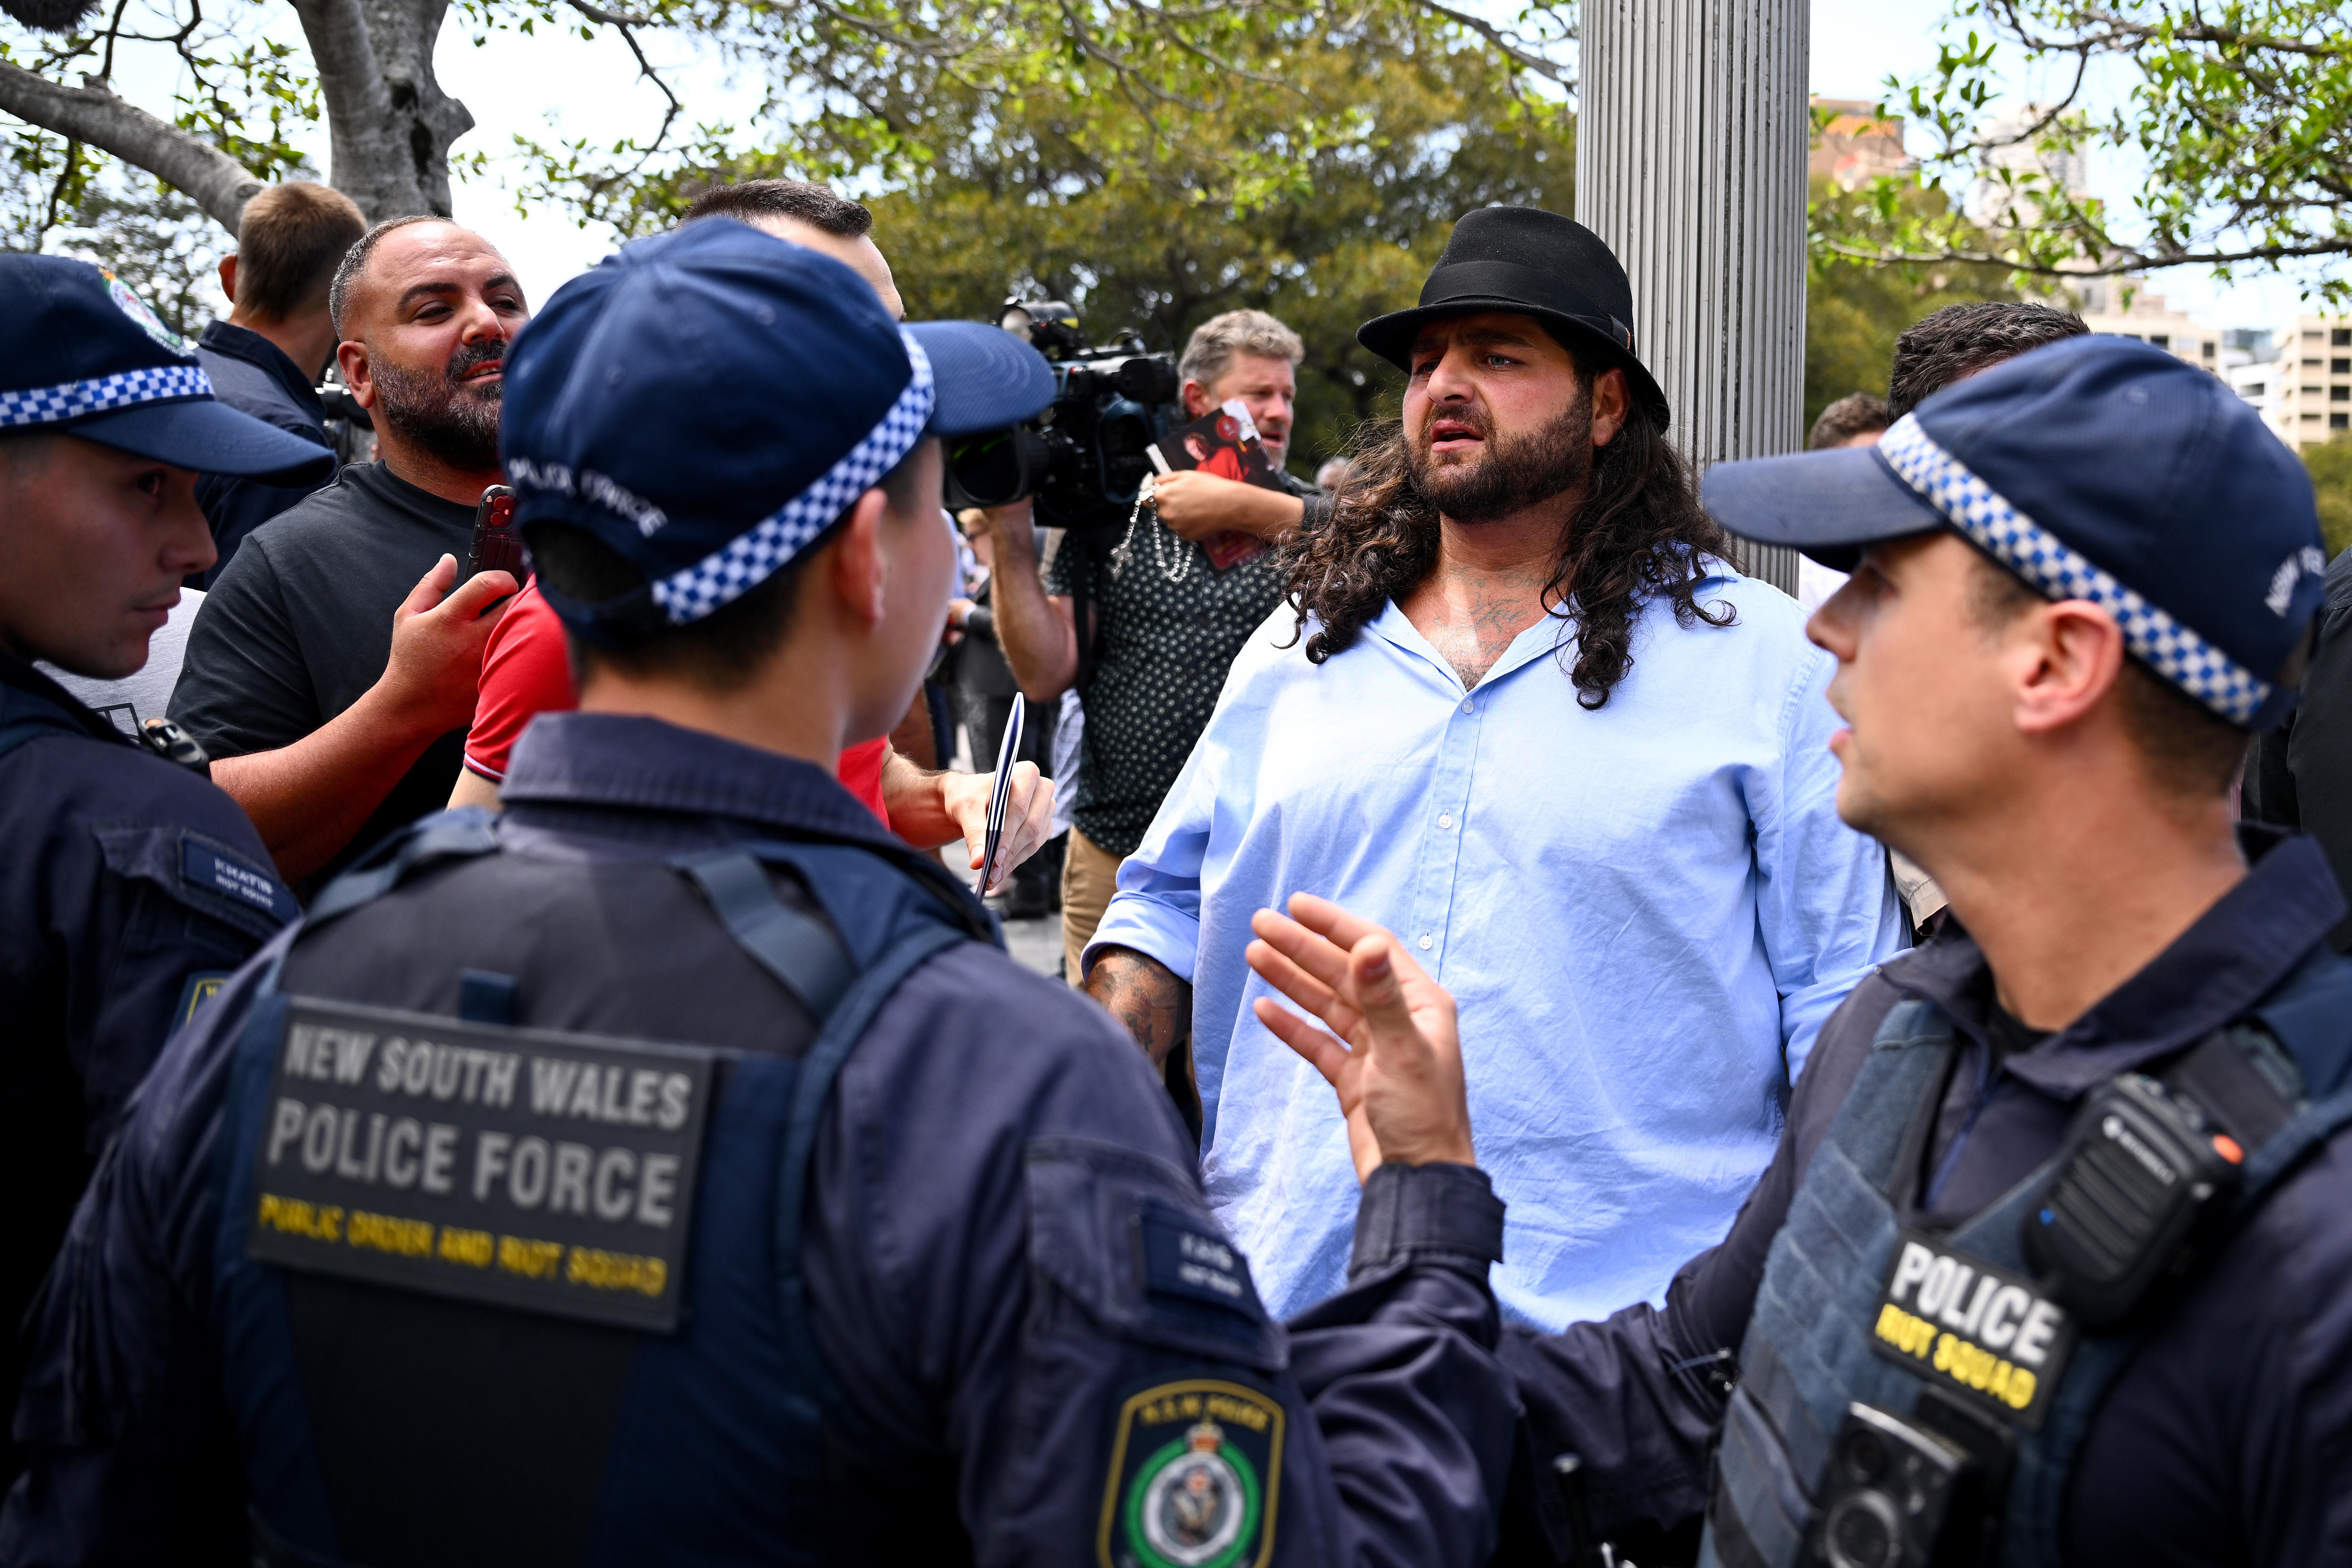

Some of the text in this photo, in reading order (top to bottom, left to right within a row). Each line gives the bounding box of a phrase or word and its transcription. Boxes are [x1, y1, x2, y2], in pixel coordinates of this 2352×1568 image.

[284, 1022, 691, 1130] NEW SOUTH WALES
[268, 1097, 681, 1228] POLICE FORCE
[258, 1193, 345, 1242] PUBLIC
[437, 1225, 494, 1268] AND
[497, 1234, 563, 1282] RIOT
[565, 1245, 667, 1297] SQUAD
[1875, 1303, 2037, 1409] RIOT SQUAD
[1890, 1242, 2063, 1365] POLICE
